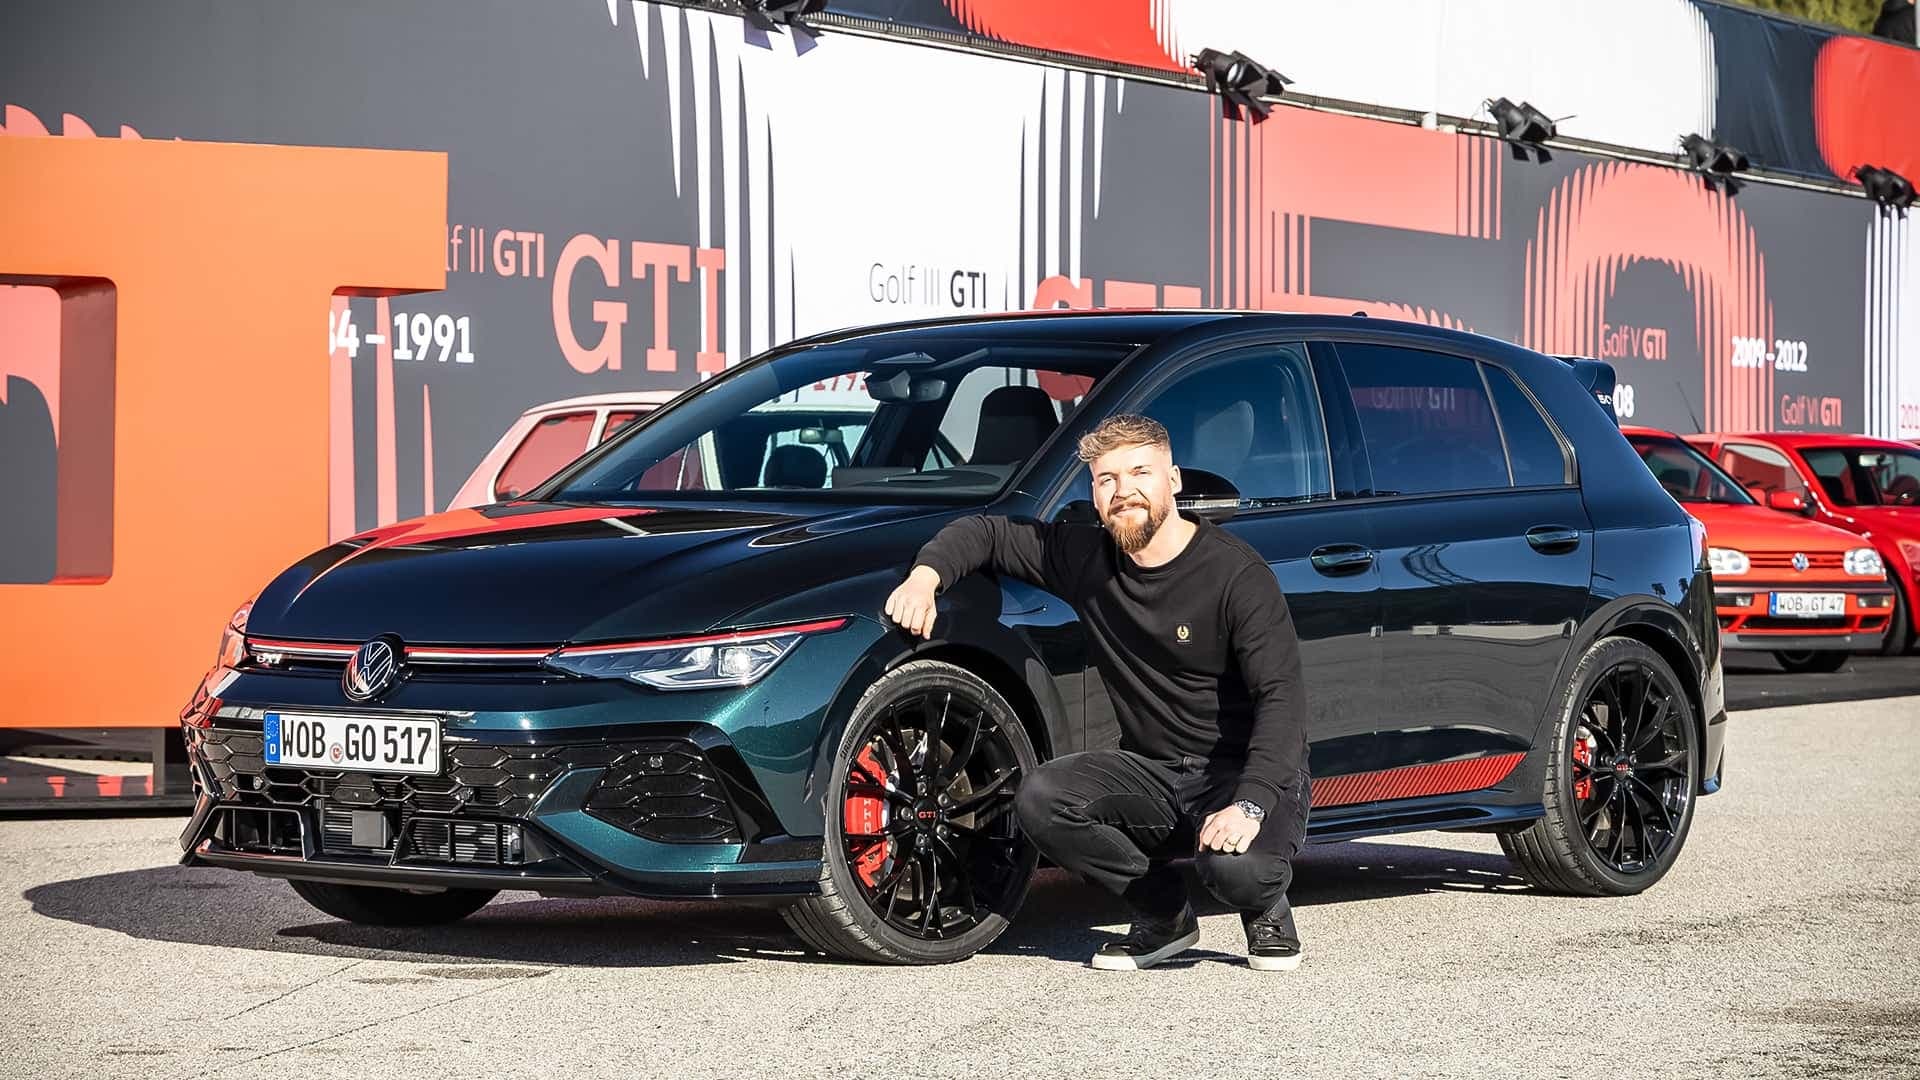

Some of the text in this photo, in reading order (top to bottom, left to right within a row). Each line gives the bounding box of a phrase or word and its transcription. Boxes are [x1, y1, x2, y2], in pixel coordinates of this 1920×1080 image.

[493, 229, 545, 278] GTI
[552, 233, 725, 374] GTI
[869, 262, 915, 304] Golf
[951, 270, 986, 309] GTI
[393, 312, 474, 363] 1991
[1601, 324, 1666, 360] Golf V GTI
[1781, 394, 1806, 426] Golf
[1821, 397, 1842, 427] GTI
[281, 719, 433, 766] WOB GO 517
[919, 810, 937, 819] GTI
